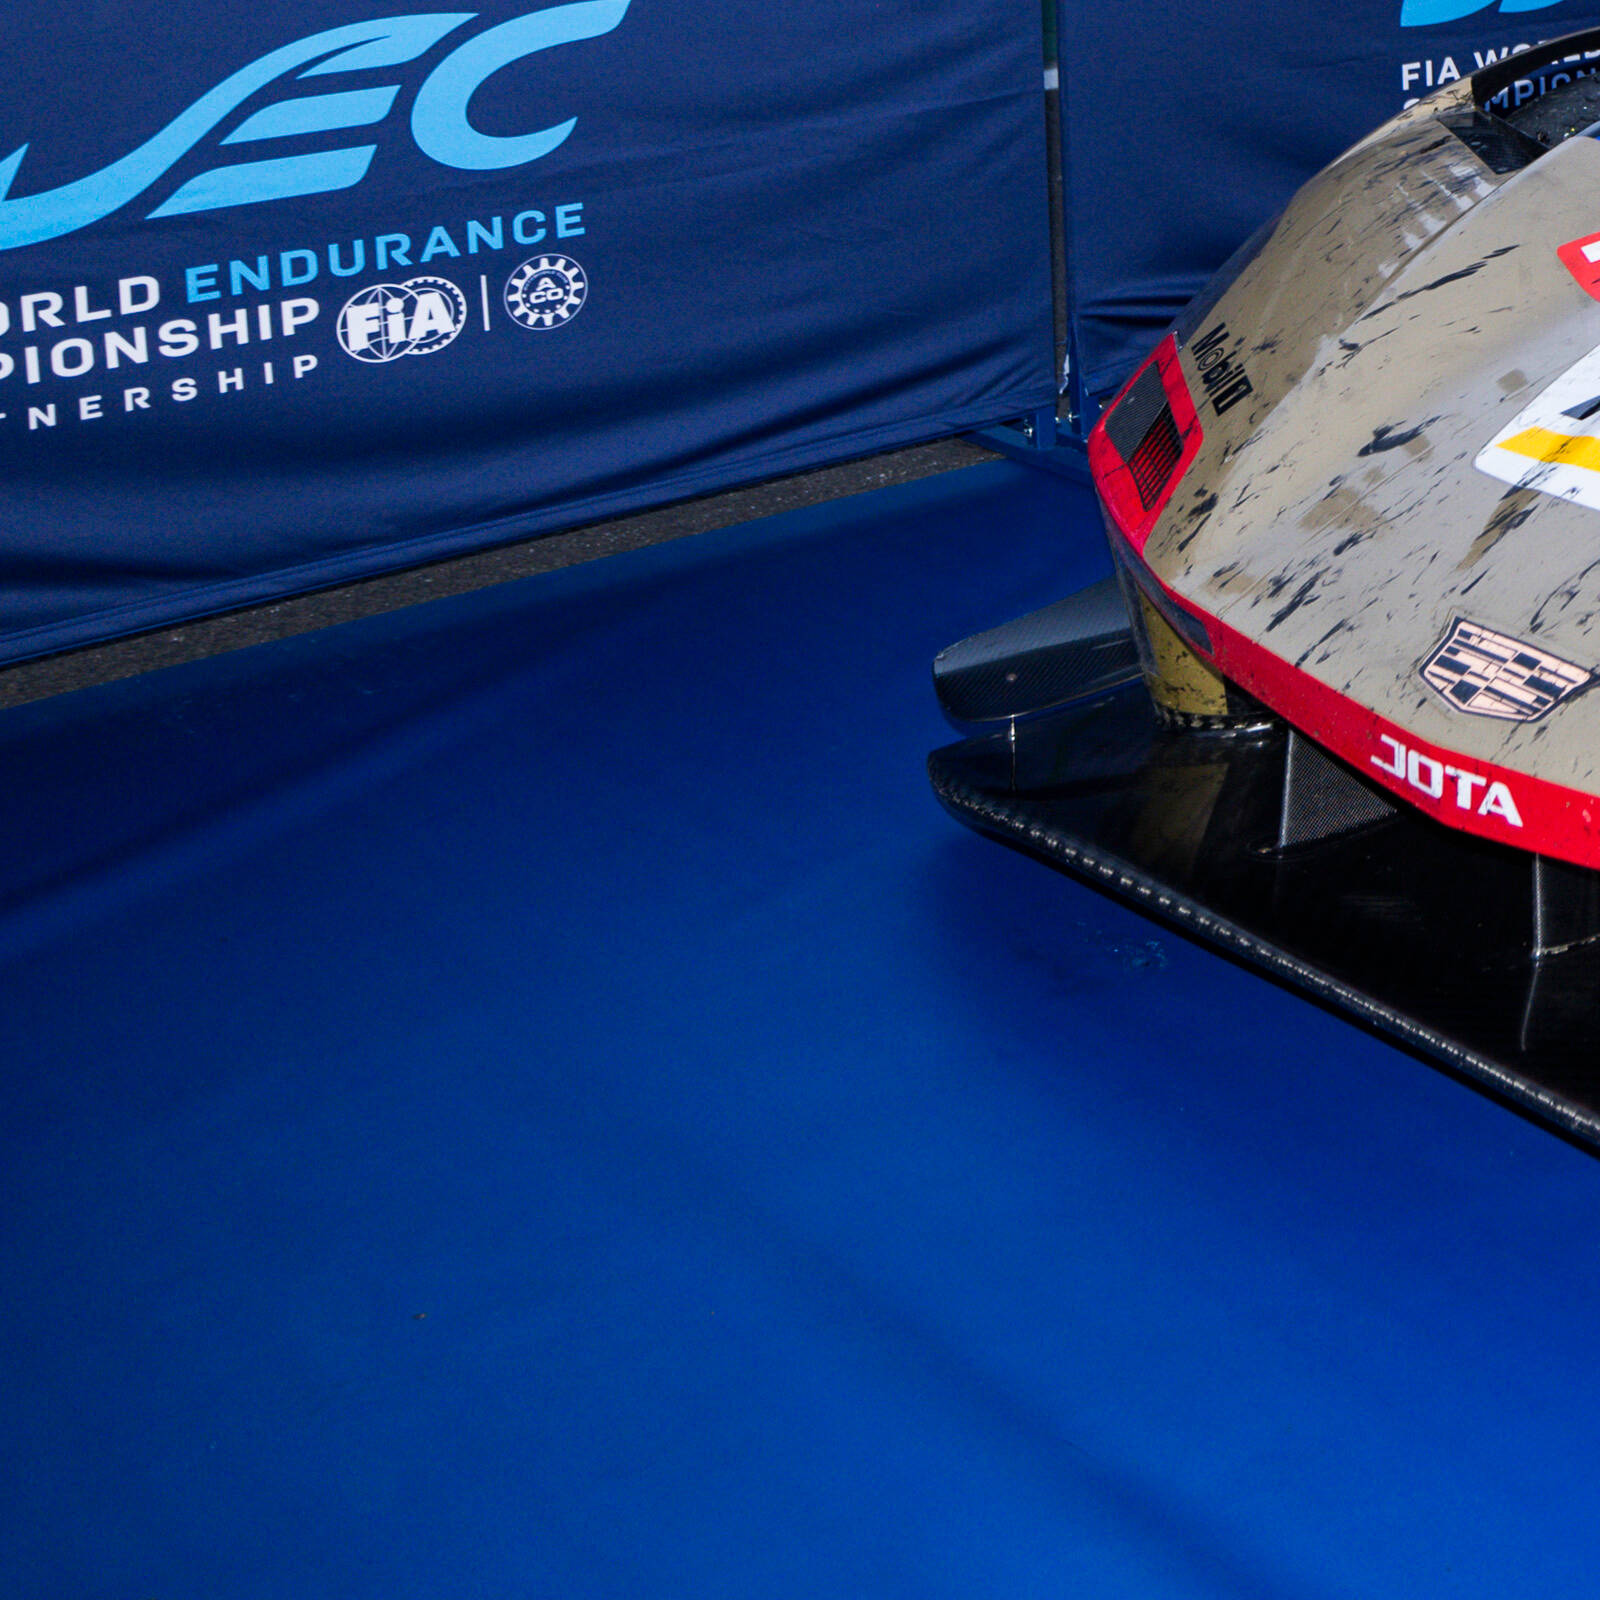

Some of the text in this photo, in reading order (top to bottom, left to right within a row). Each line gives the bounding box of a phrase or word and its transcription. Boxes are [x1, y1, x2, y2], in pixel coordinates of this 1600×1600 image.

[1402, 55, 1461, 92] FIA
[0, 203, 587, 333] RLD ENDURANCE
[0, 354, 319, 431] NERSHIP
[1191, 322, 1246, 398] Mobil
[1370, 733, 1524, 828] JOTA
